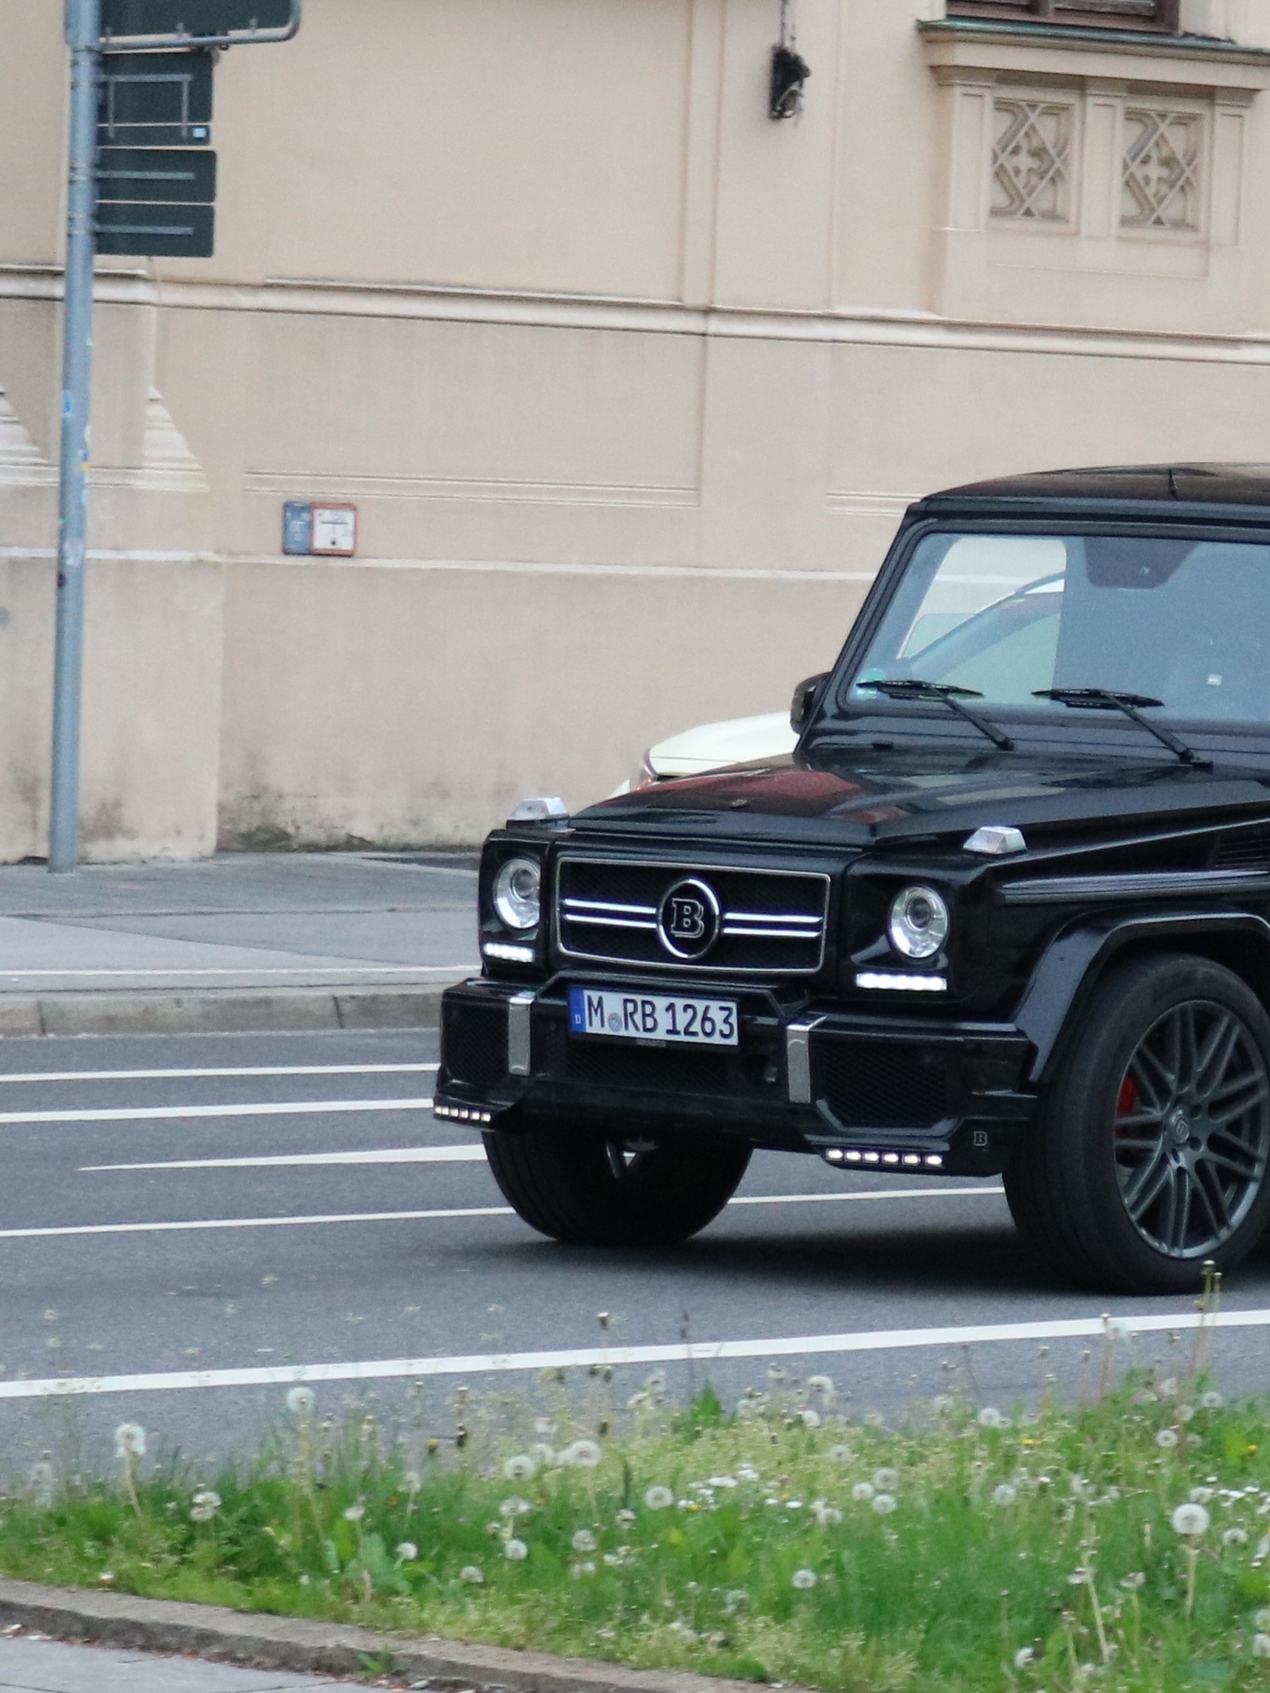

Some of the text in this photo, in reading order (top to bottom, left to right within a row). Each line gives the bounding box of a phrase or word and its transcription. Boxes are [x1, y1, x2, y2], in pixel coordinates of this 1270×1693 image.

[671, 898, 704, 938] B
[575, 1014, 582, 1024] D
[587, 995, 605, 1028] M
[665, 1003, 735, 1039] 1263
